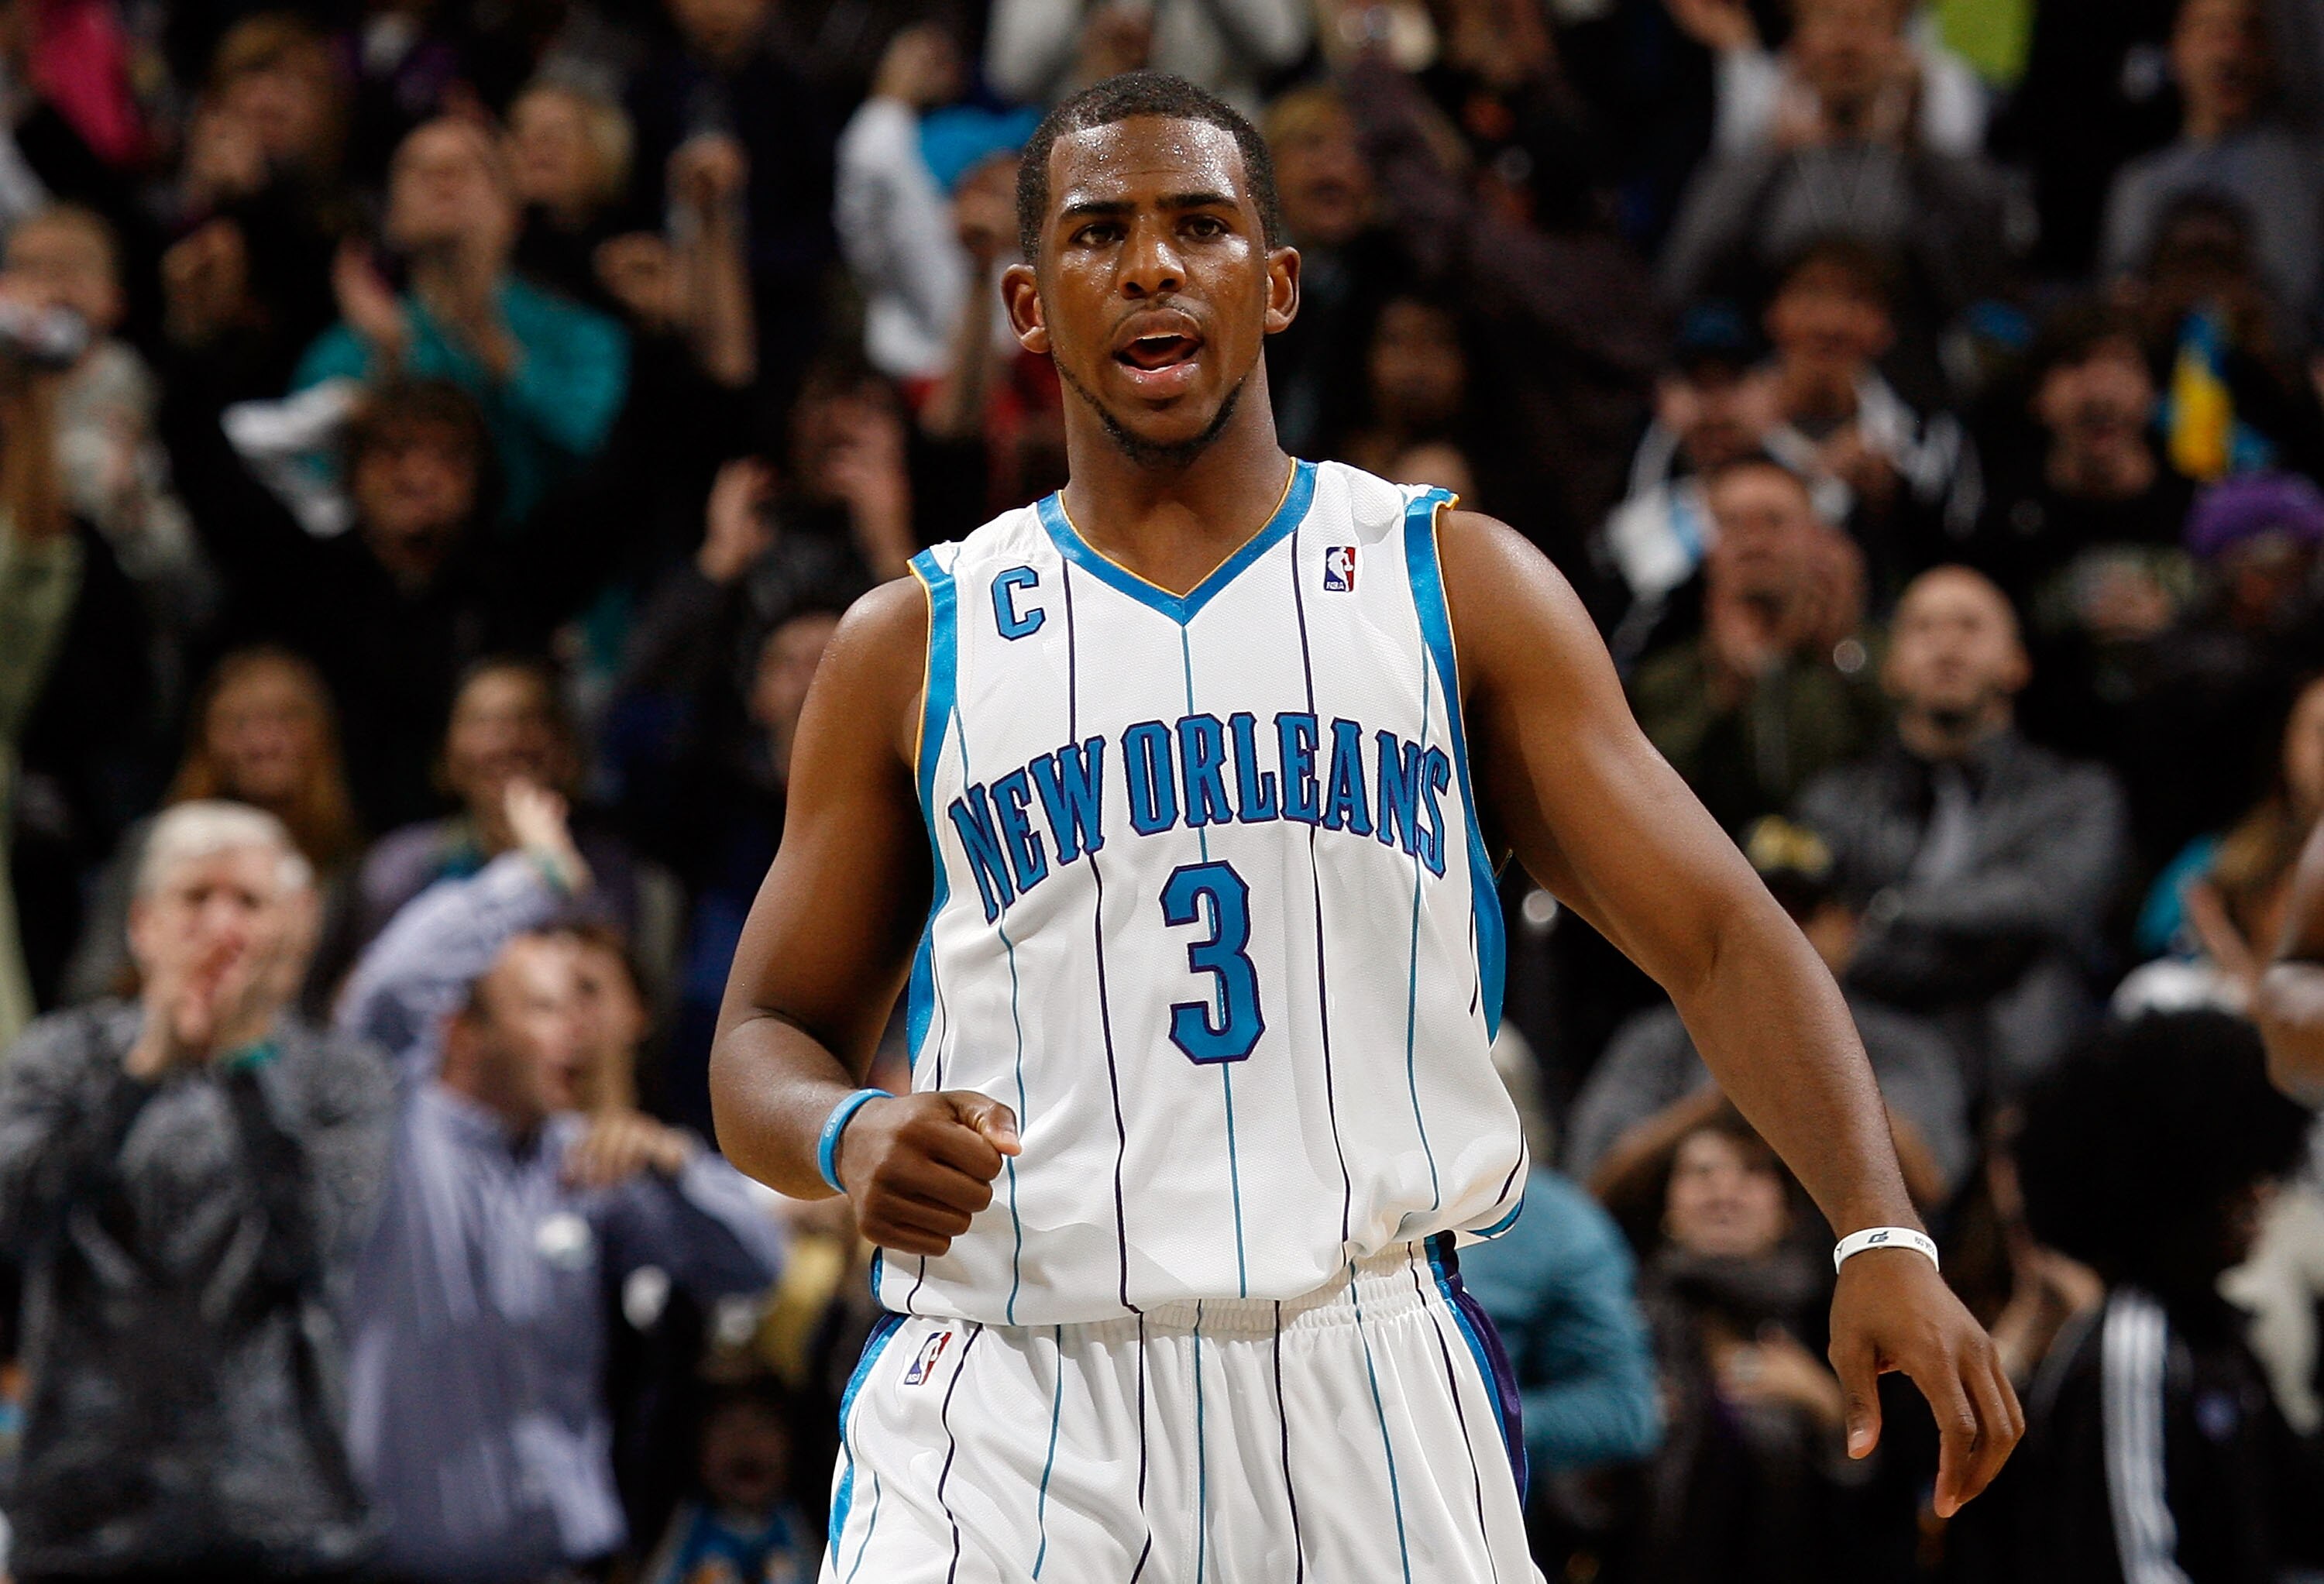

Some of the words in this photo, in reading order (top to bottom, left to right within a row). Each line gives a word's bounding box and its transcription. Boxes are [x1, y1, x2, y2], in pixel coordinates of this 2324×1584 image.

[991, 566, 1046, 641] C
[949, 736, 1106, 925] NEW
[1121, 712, 1451, 880] ORLEANS
[1160, 861, 1265, 1065] 3
